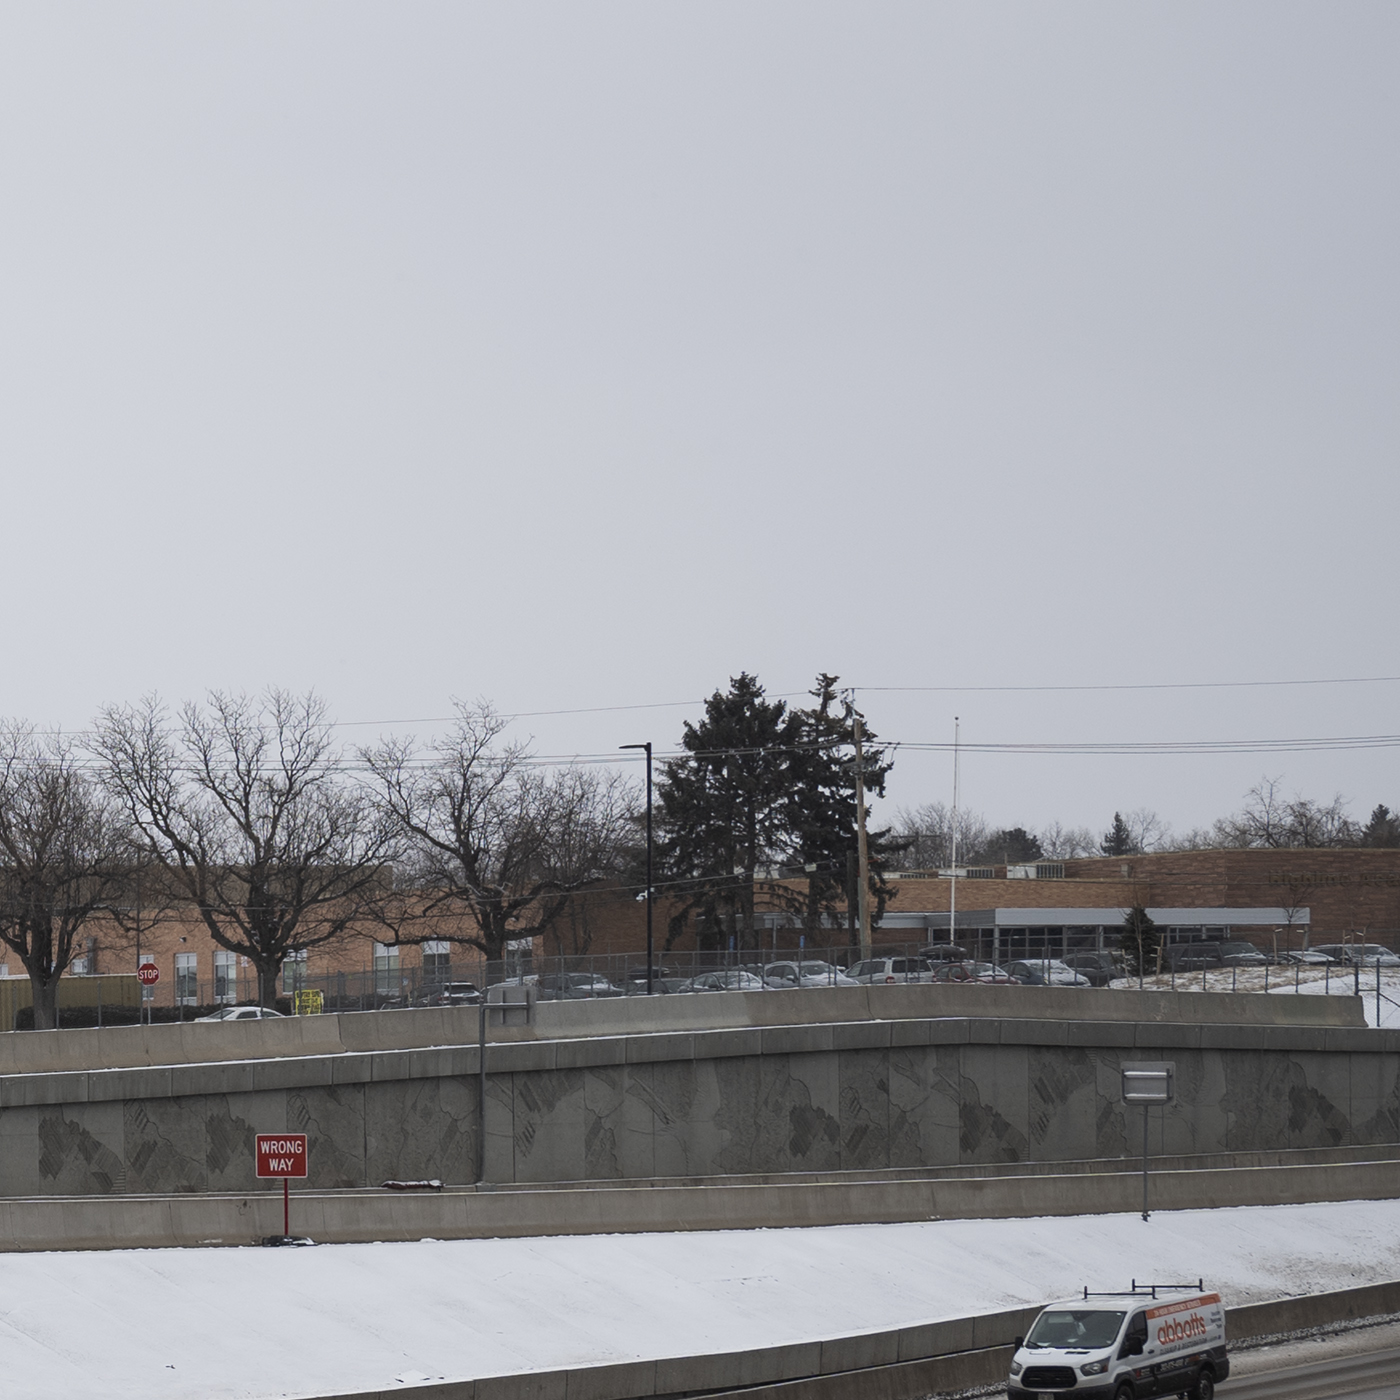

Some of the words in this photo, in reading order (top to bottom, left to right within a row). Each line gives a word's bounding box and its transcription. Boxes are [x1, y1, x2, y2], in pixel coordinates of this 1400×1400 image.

[138, 969, 158, 979] STOP
[260, 1140, 303, 1154] WRONG
[269, 1158, 294, 1172] WAY
[1157, 1312, 1207, 1345] abbotts
